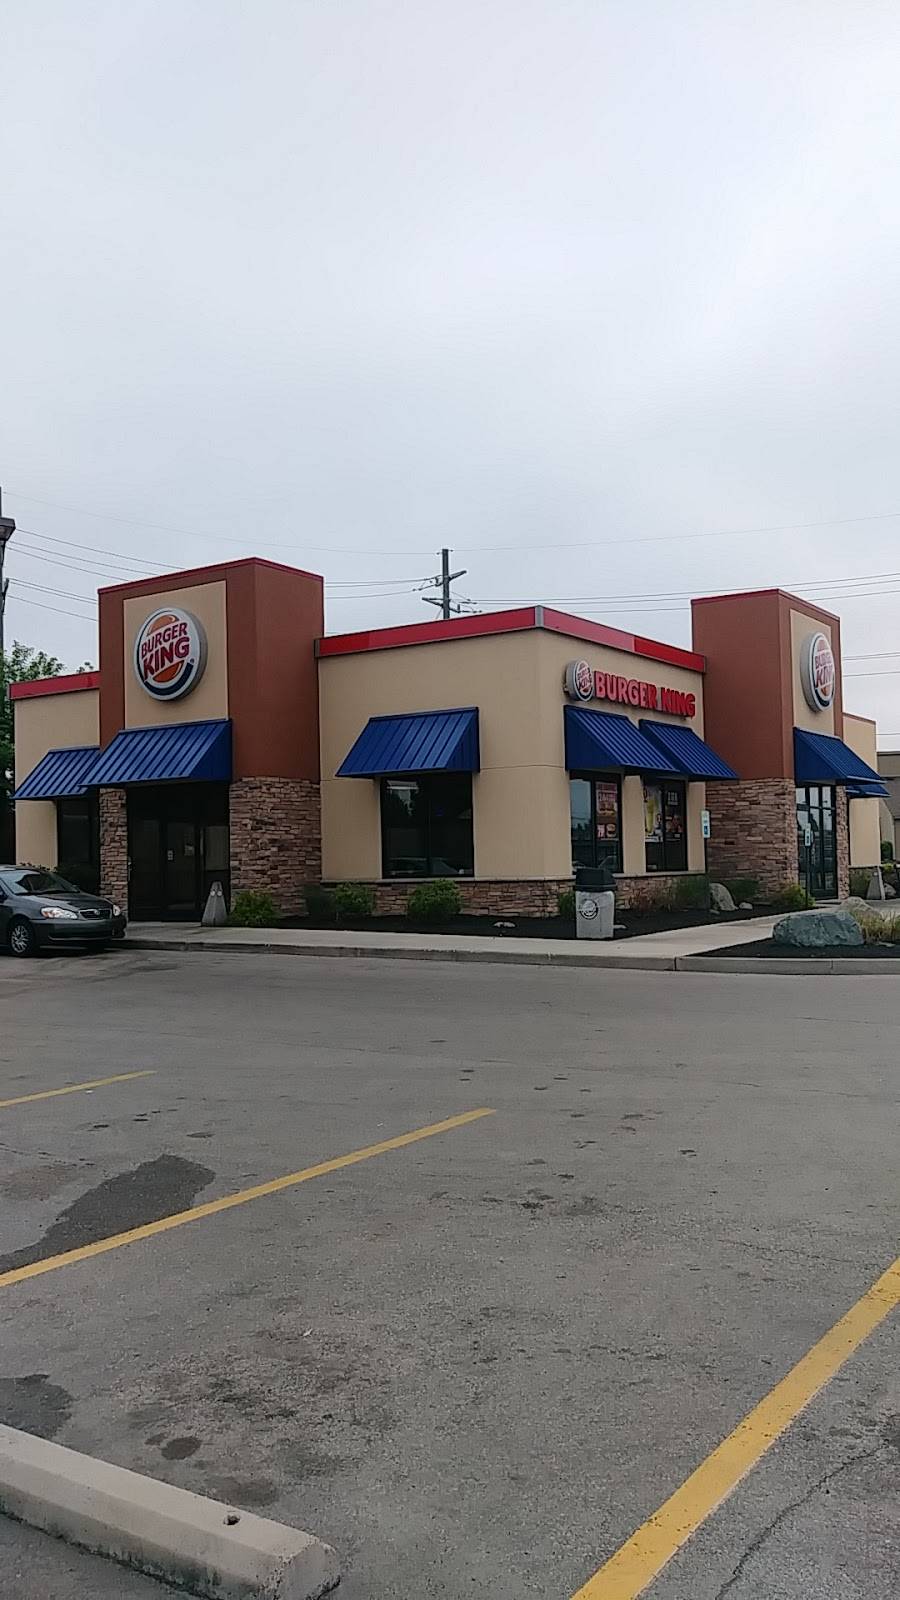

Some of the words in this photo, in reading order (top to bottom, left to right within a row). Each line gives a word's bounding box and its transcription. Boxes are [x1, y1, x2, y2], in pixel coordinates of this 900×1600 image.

[141, 622, 187, 658] BURGER
[143, 637, 189, 680] KING
[594, 670, 657, 709] BURGER
[660, 687, 695, 717] KING
[815, 663, 834, 688] KIN
